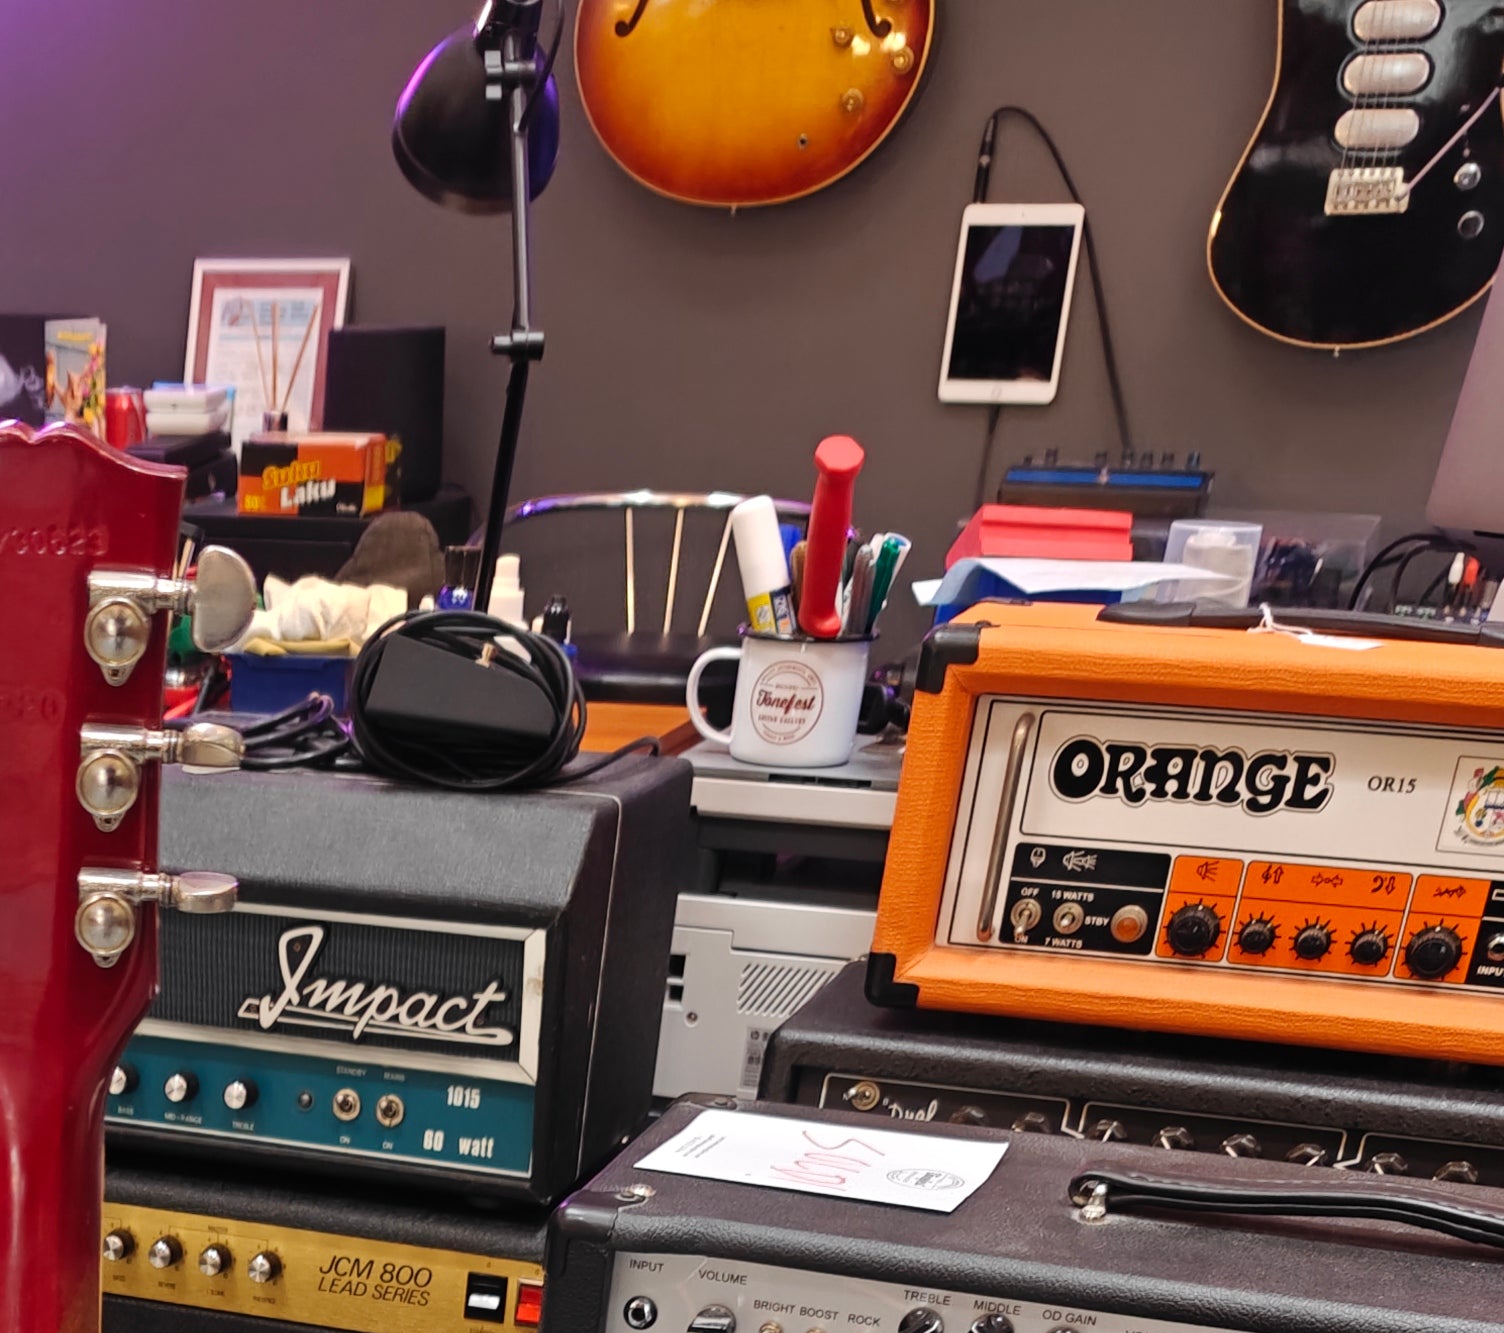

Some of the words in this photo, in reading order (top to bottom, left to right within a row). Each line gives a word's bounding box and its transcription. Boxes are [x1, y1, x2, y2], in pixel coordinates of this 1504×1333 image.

[280, 478, 336, 510] Laku
[756, 689, 816, 715] Tonefest
[1051, 737, 1334, 815] ORANGE
[1368, 775, 1417, 794] OR15
[1020, 887, 1039, 898] OFF
[1063, 890, 1094, 902] WATTS
[1084, 916, 1110, 927] STBY
[1052, 938, 1083, 949] WATTS
[1477, 965, 1504, 978] INPU
[237, 925, 514, 1046] Impact
[447, 1084, 481, 1109] 1015
[339, 1136, 351, 1145] ON
[382, 1141, 394, 1150] ON
[423, 1129, 444, 1152] 60
[458, 1136, 494, 1159] watt
[319, 1255, 375, 1280] JCM
[379, 1262, 432, 1289] 800
[629, 1259, 664, 1273] INPUT
[698, 1269, 748, 1286] VOLUME
[318, 1276, 367, 1297] LEAD
[371, 1285, 431, 1307] SERIES
[904, 1289, 951, 1306] TREBLE
[753, 1299, 796, 1315] BRIGHT
[799, 1306, 839, 1321] BOOST
[973, 1299, 1022, 1316] MIDDLE
[847, 1313, 881, 1327] ROCK
[1042, 1309, 1062, 1321] OD
[1065, 1312, 1097, 1326] GAIN
